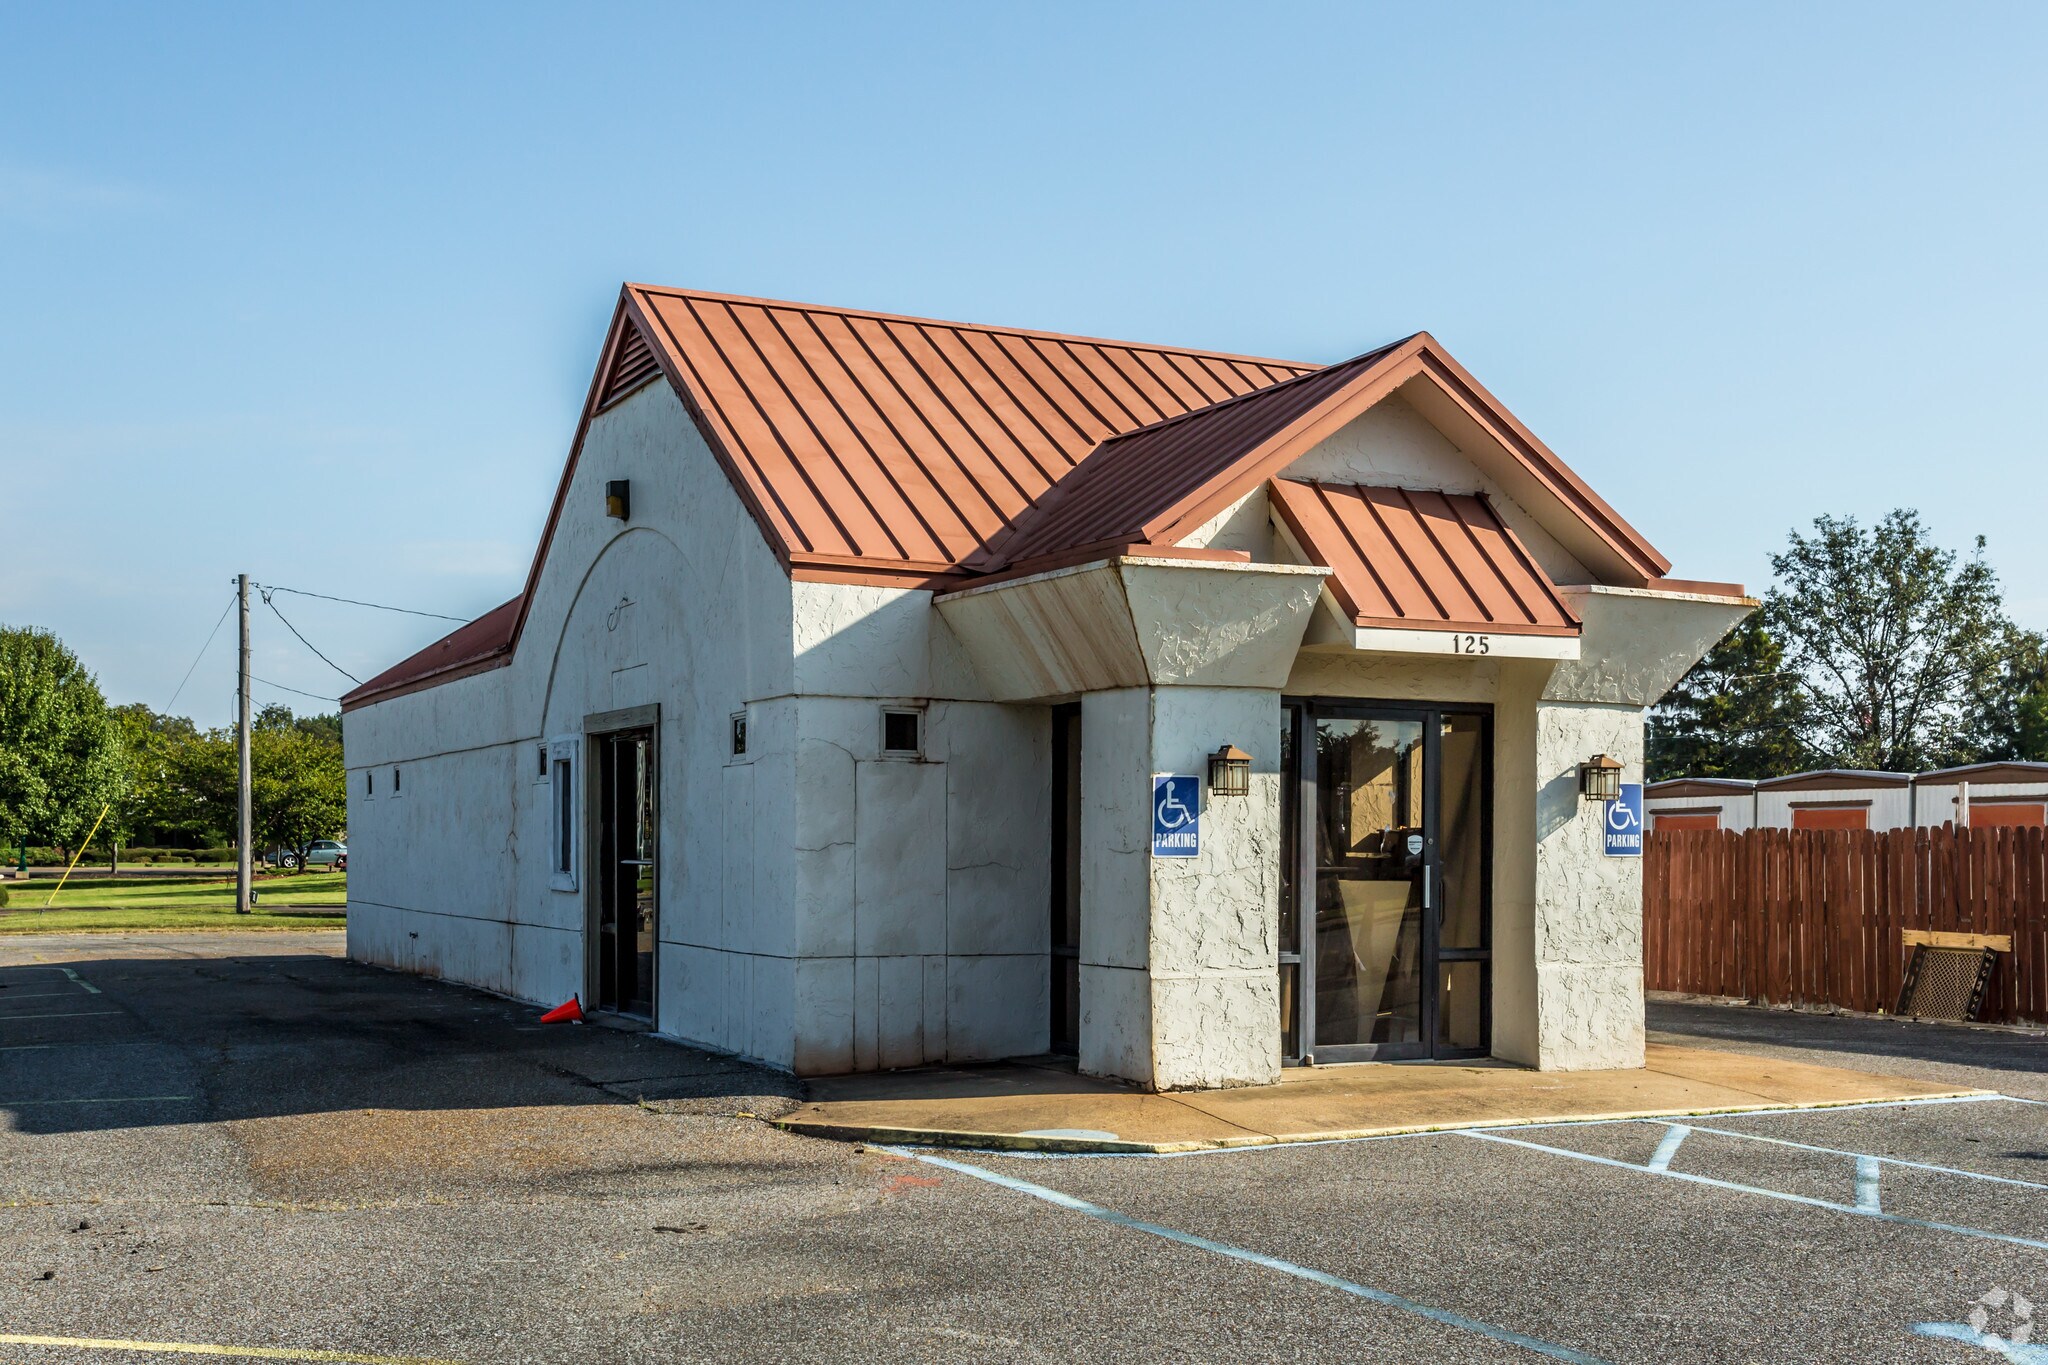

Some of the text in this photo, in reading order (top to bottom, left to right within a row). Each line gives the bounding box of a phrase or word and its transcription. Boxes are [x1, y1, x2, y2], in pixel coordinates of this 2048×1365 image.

[1453, 634, 1490, 655] 125
[1155, 833, 1197, 848] PARKING
[1607, 834, 1640, 848] PARKING
